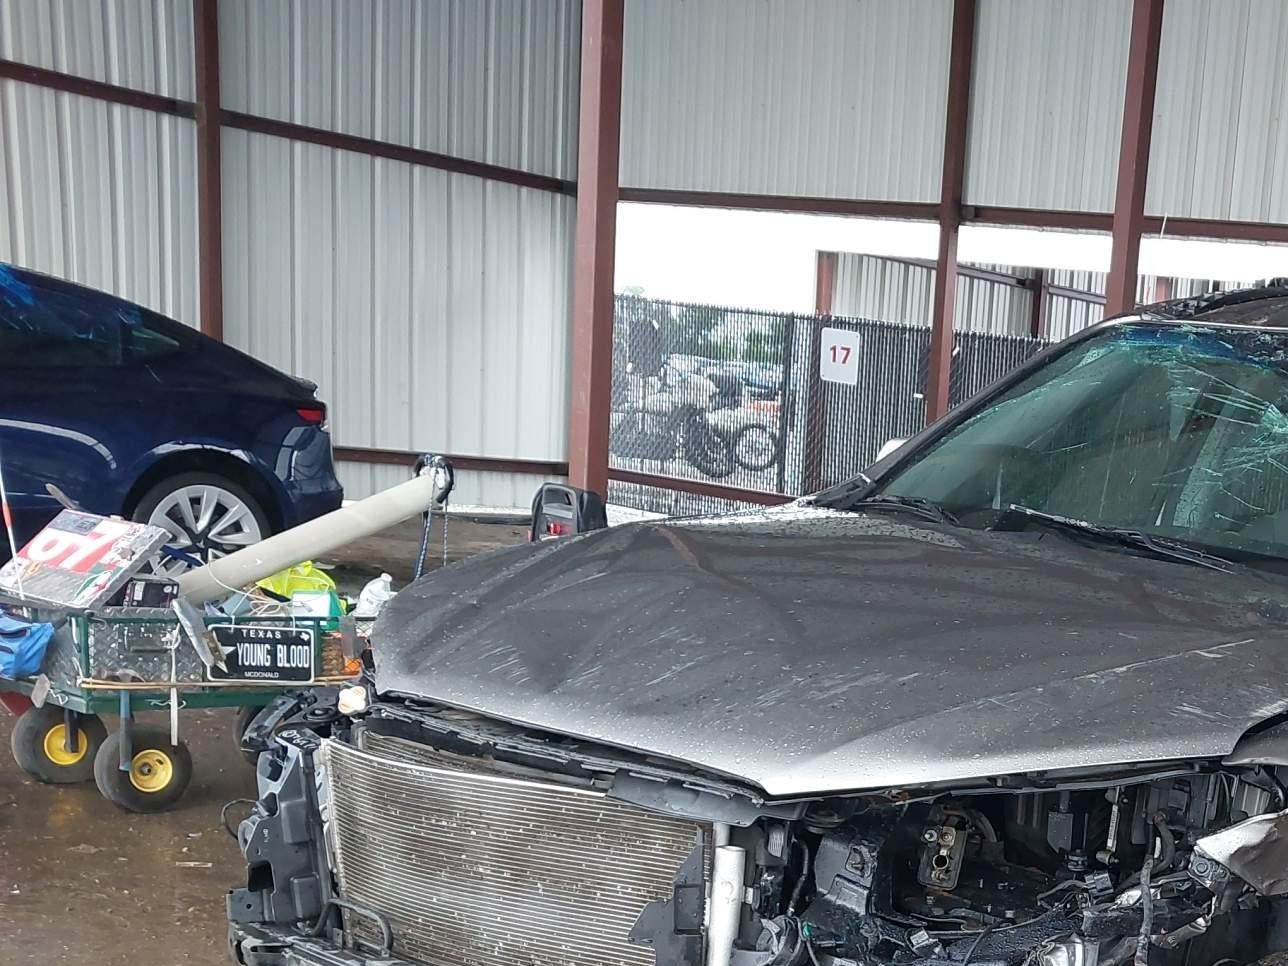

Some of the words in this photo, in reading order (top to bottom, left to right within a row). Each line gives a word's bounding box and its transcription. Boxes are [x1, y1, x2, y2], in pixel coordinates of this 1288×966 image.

[830, 345, 851, 364] 17
[241, 629, 281, 639] TEXAS
[236, 643, 271, 666] YOUNG
[277, 644, 310, 668] BLOOD
